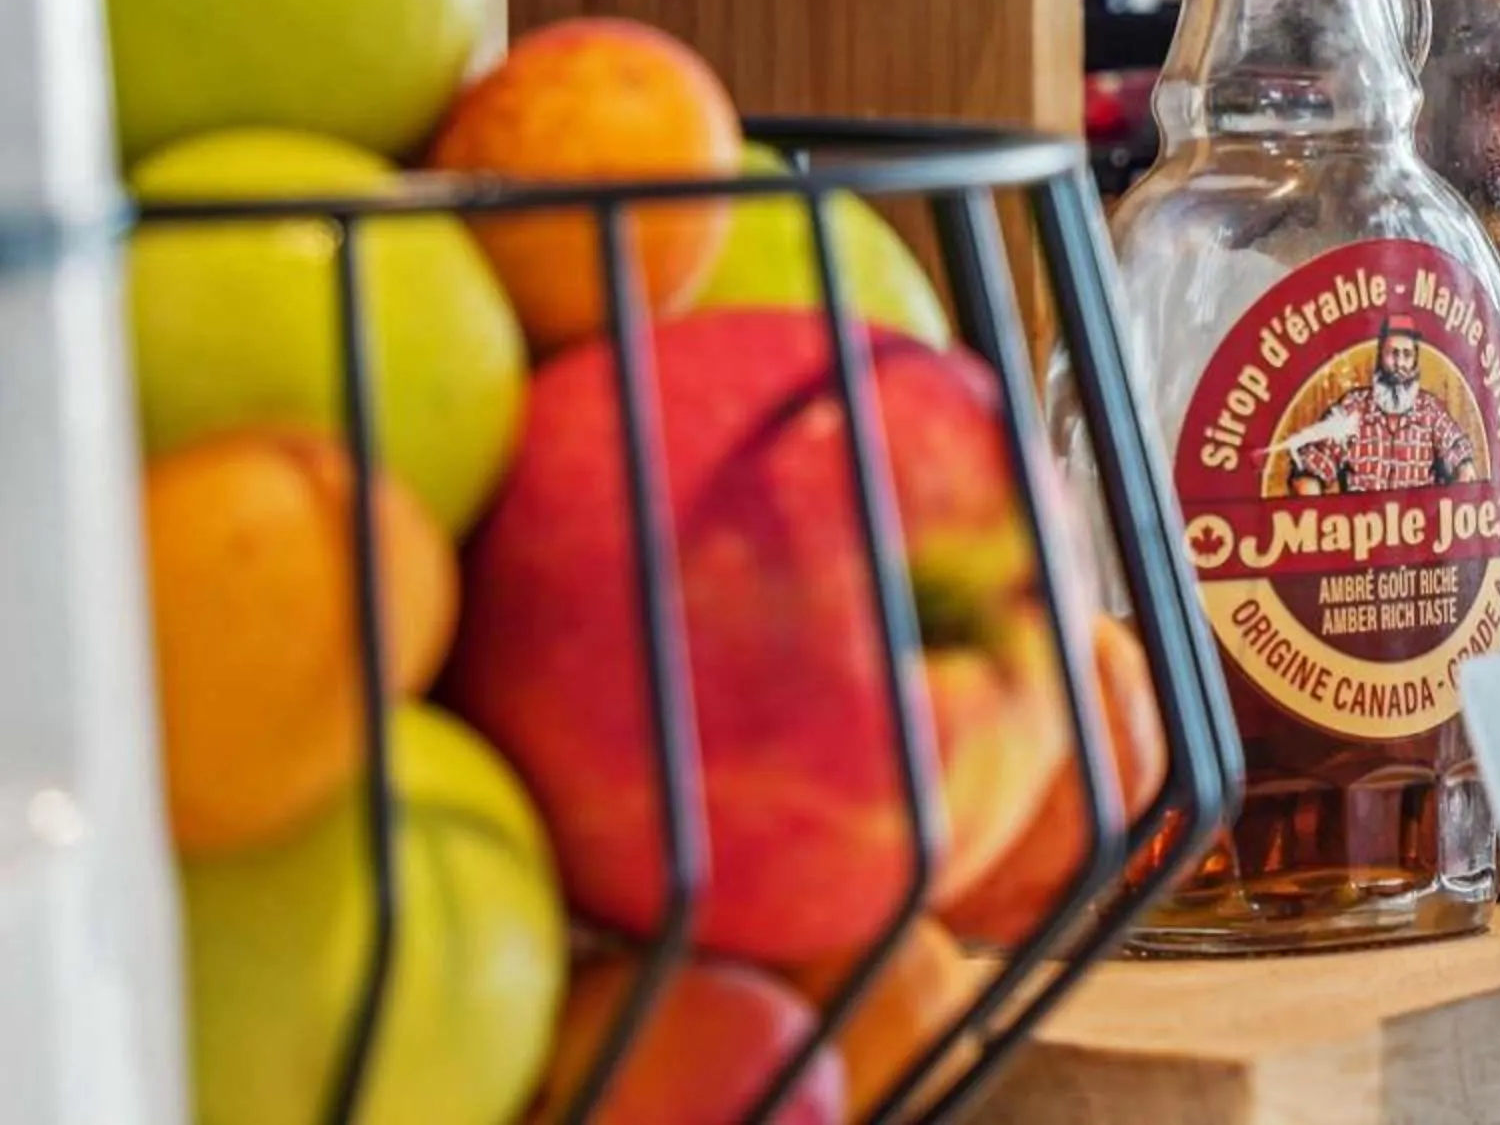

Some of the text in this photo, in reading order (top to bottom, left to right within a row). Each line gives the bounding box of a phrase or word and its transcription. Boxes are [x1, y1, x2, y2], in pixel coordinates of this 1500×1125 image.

[1200, 364, 1271, 472] Sirop
[1259, 267, 1387, 369] d'érable
[1412, 267, 1484, 346] Maple
[1238, 500, 1426, 569] Maple
[1319, 564, 1459, 605] AMBRÉ GOÛT RICHE
[1321, 596, 1458, 636] AMBER RICH TASTE
[1231, 599, 1334, 703] ORIGINE
[1332, 676, 1437, 720] CANADA
